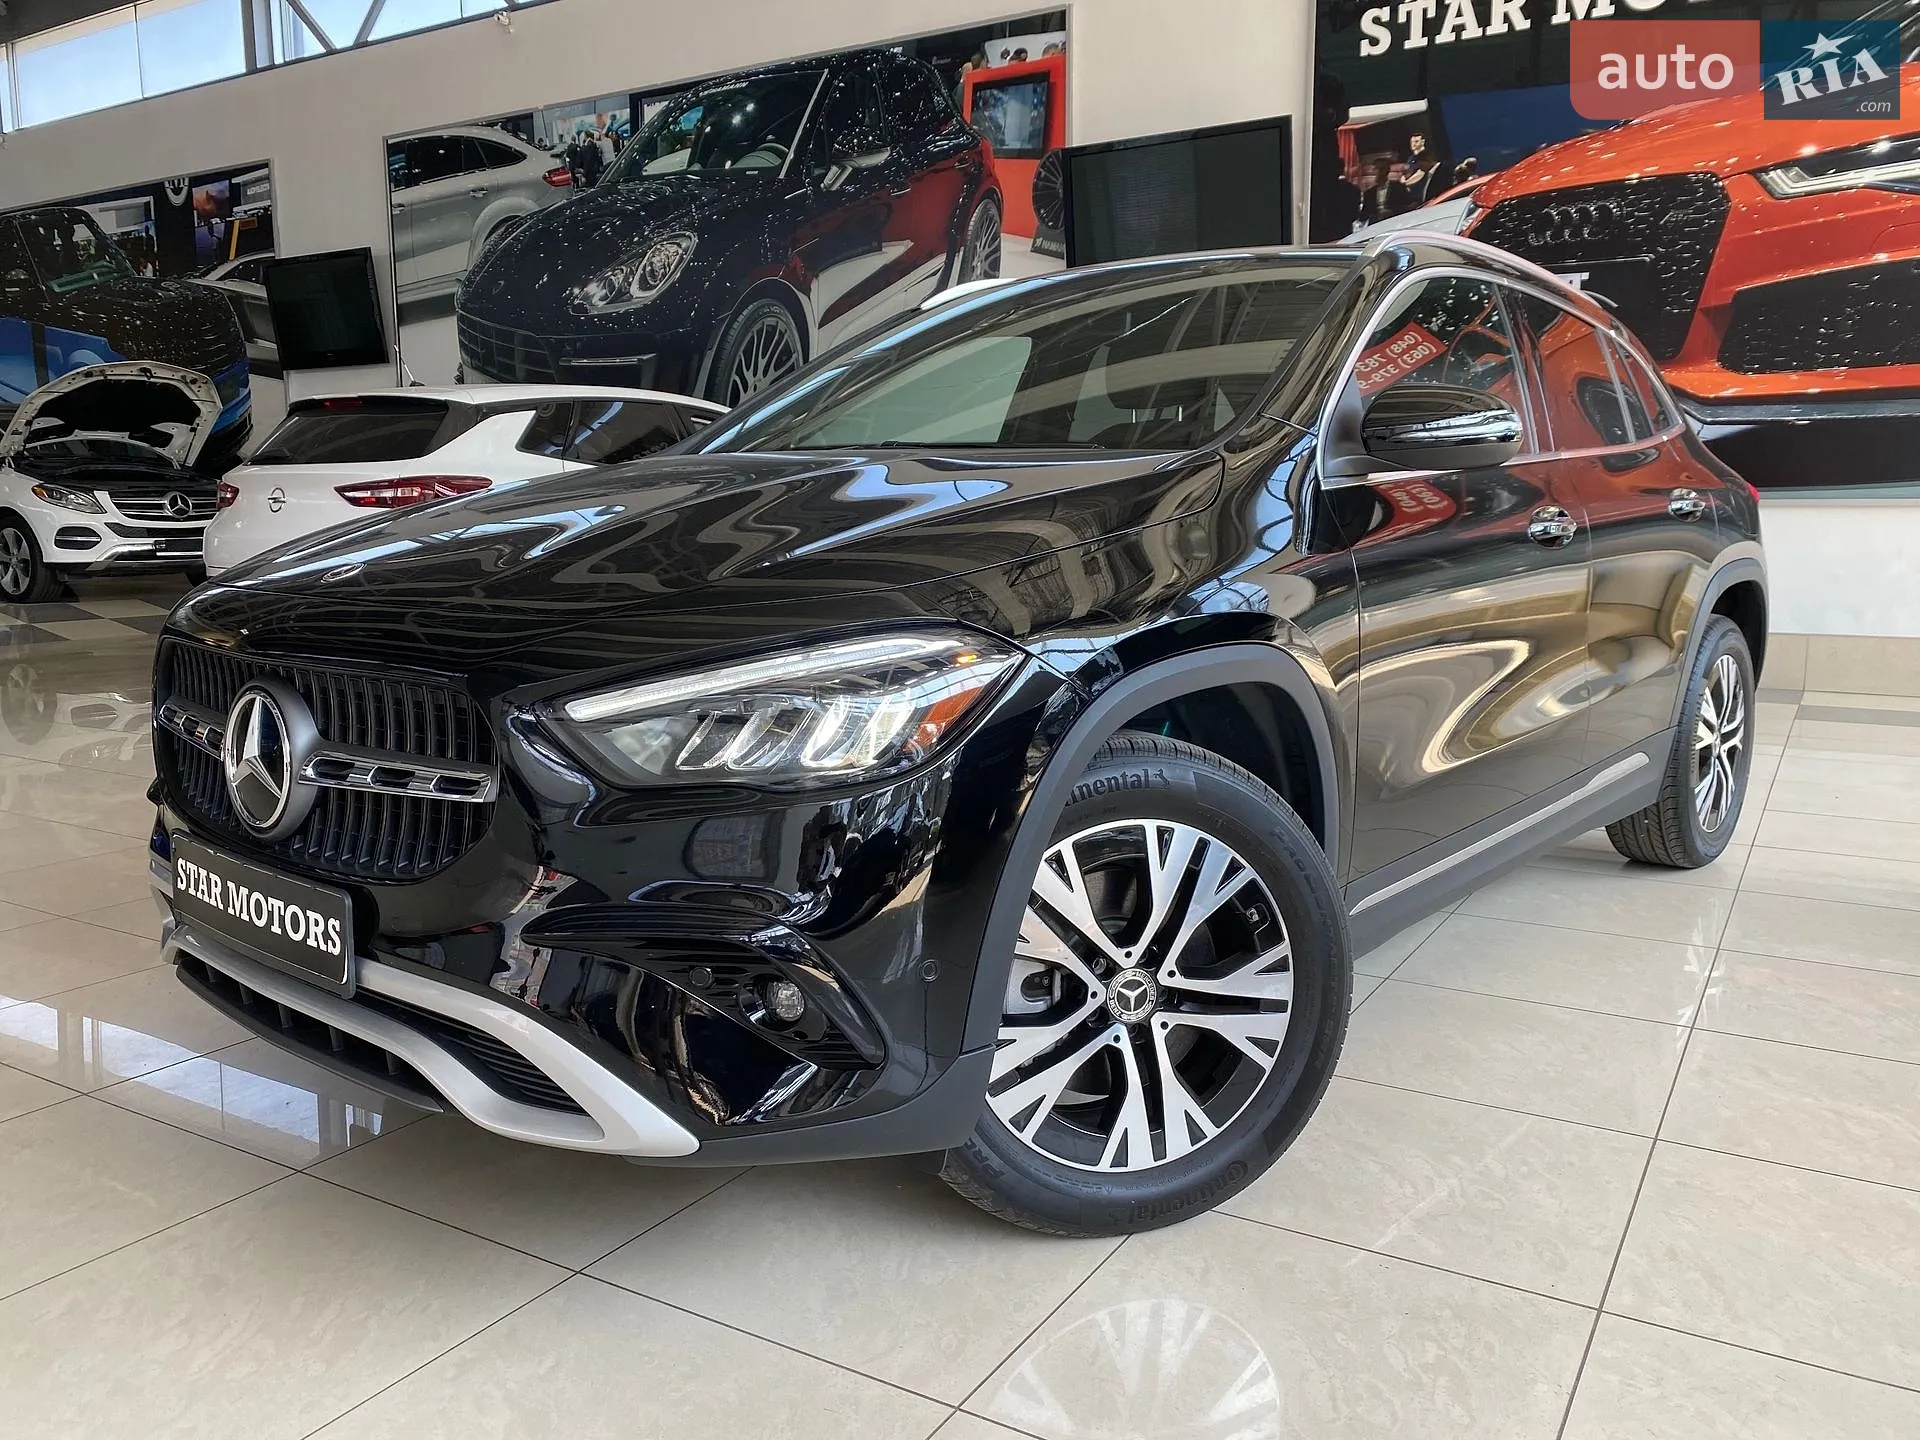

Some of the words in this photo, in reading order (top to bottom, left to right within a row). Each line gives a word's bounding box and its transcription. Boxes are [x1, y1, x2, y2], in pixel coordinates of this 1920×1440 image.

[1360, 0, 1531, 57] STAR
[1064, 768, 1150, 808] inental
[177, 857, 224, 911] STAR
[226, 880, 341, 956] MOTORS
